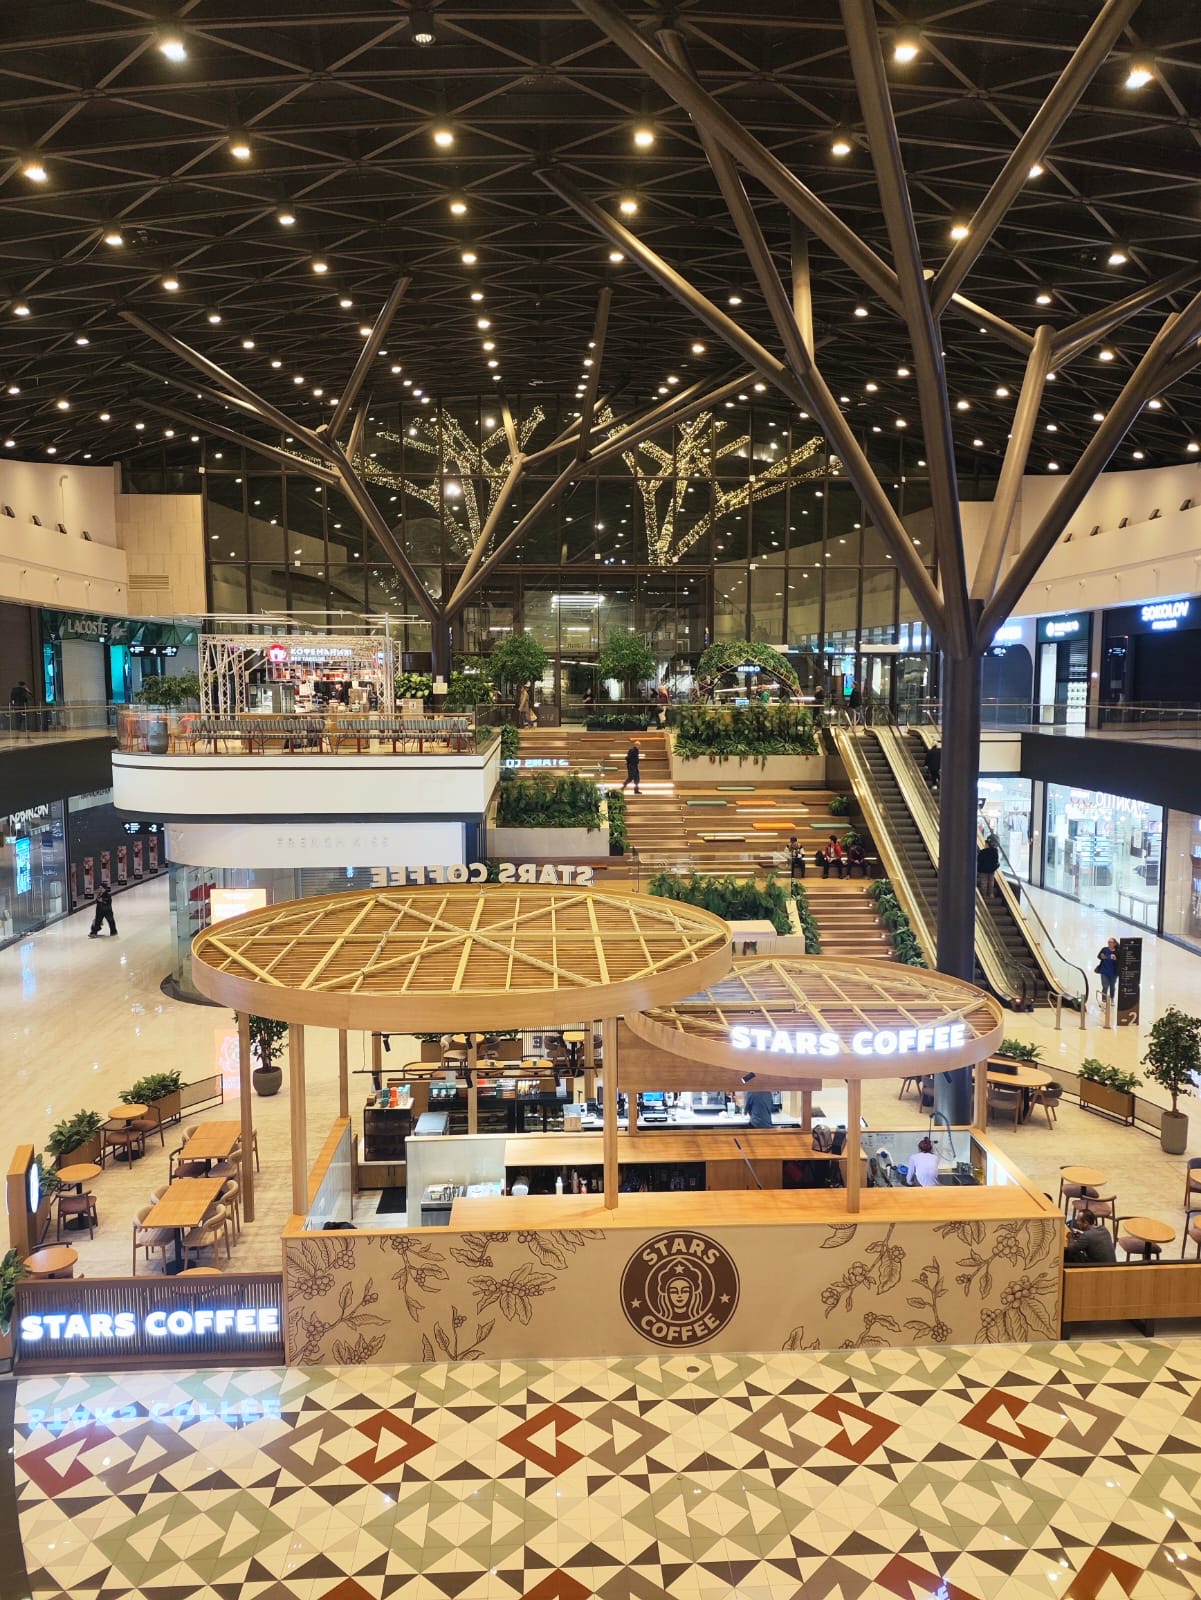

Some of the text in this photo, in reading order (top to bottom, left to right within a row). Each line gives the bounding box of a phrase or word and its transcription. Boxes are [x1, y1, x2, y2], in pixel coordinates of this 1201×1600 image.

[1142, 601, 1189, 621] SOKOLOV
[67, 619, 108, 635] LACOSTE
[1121, 1011, 1138, 1026] -2
[731, 1023, 966, 1056] STARS COFFEE
[642, 1238, 720, 1266] STARS
[20, 1308, 279, 1341] STARS COFFEE
[640, 1313, 720, 1341] COFFEE
